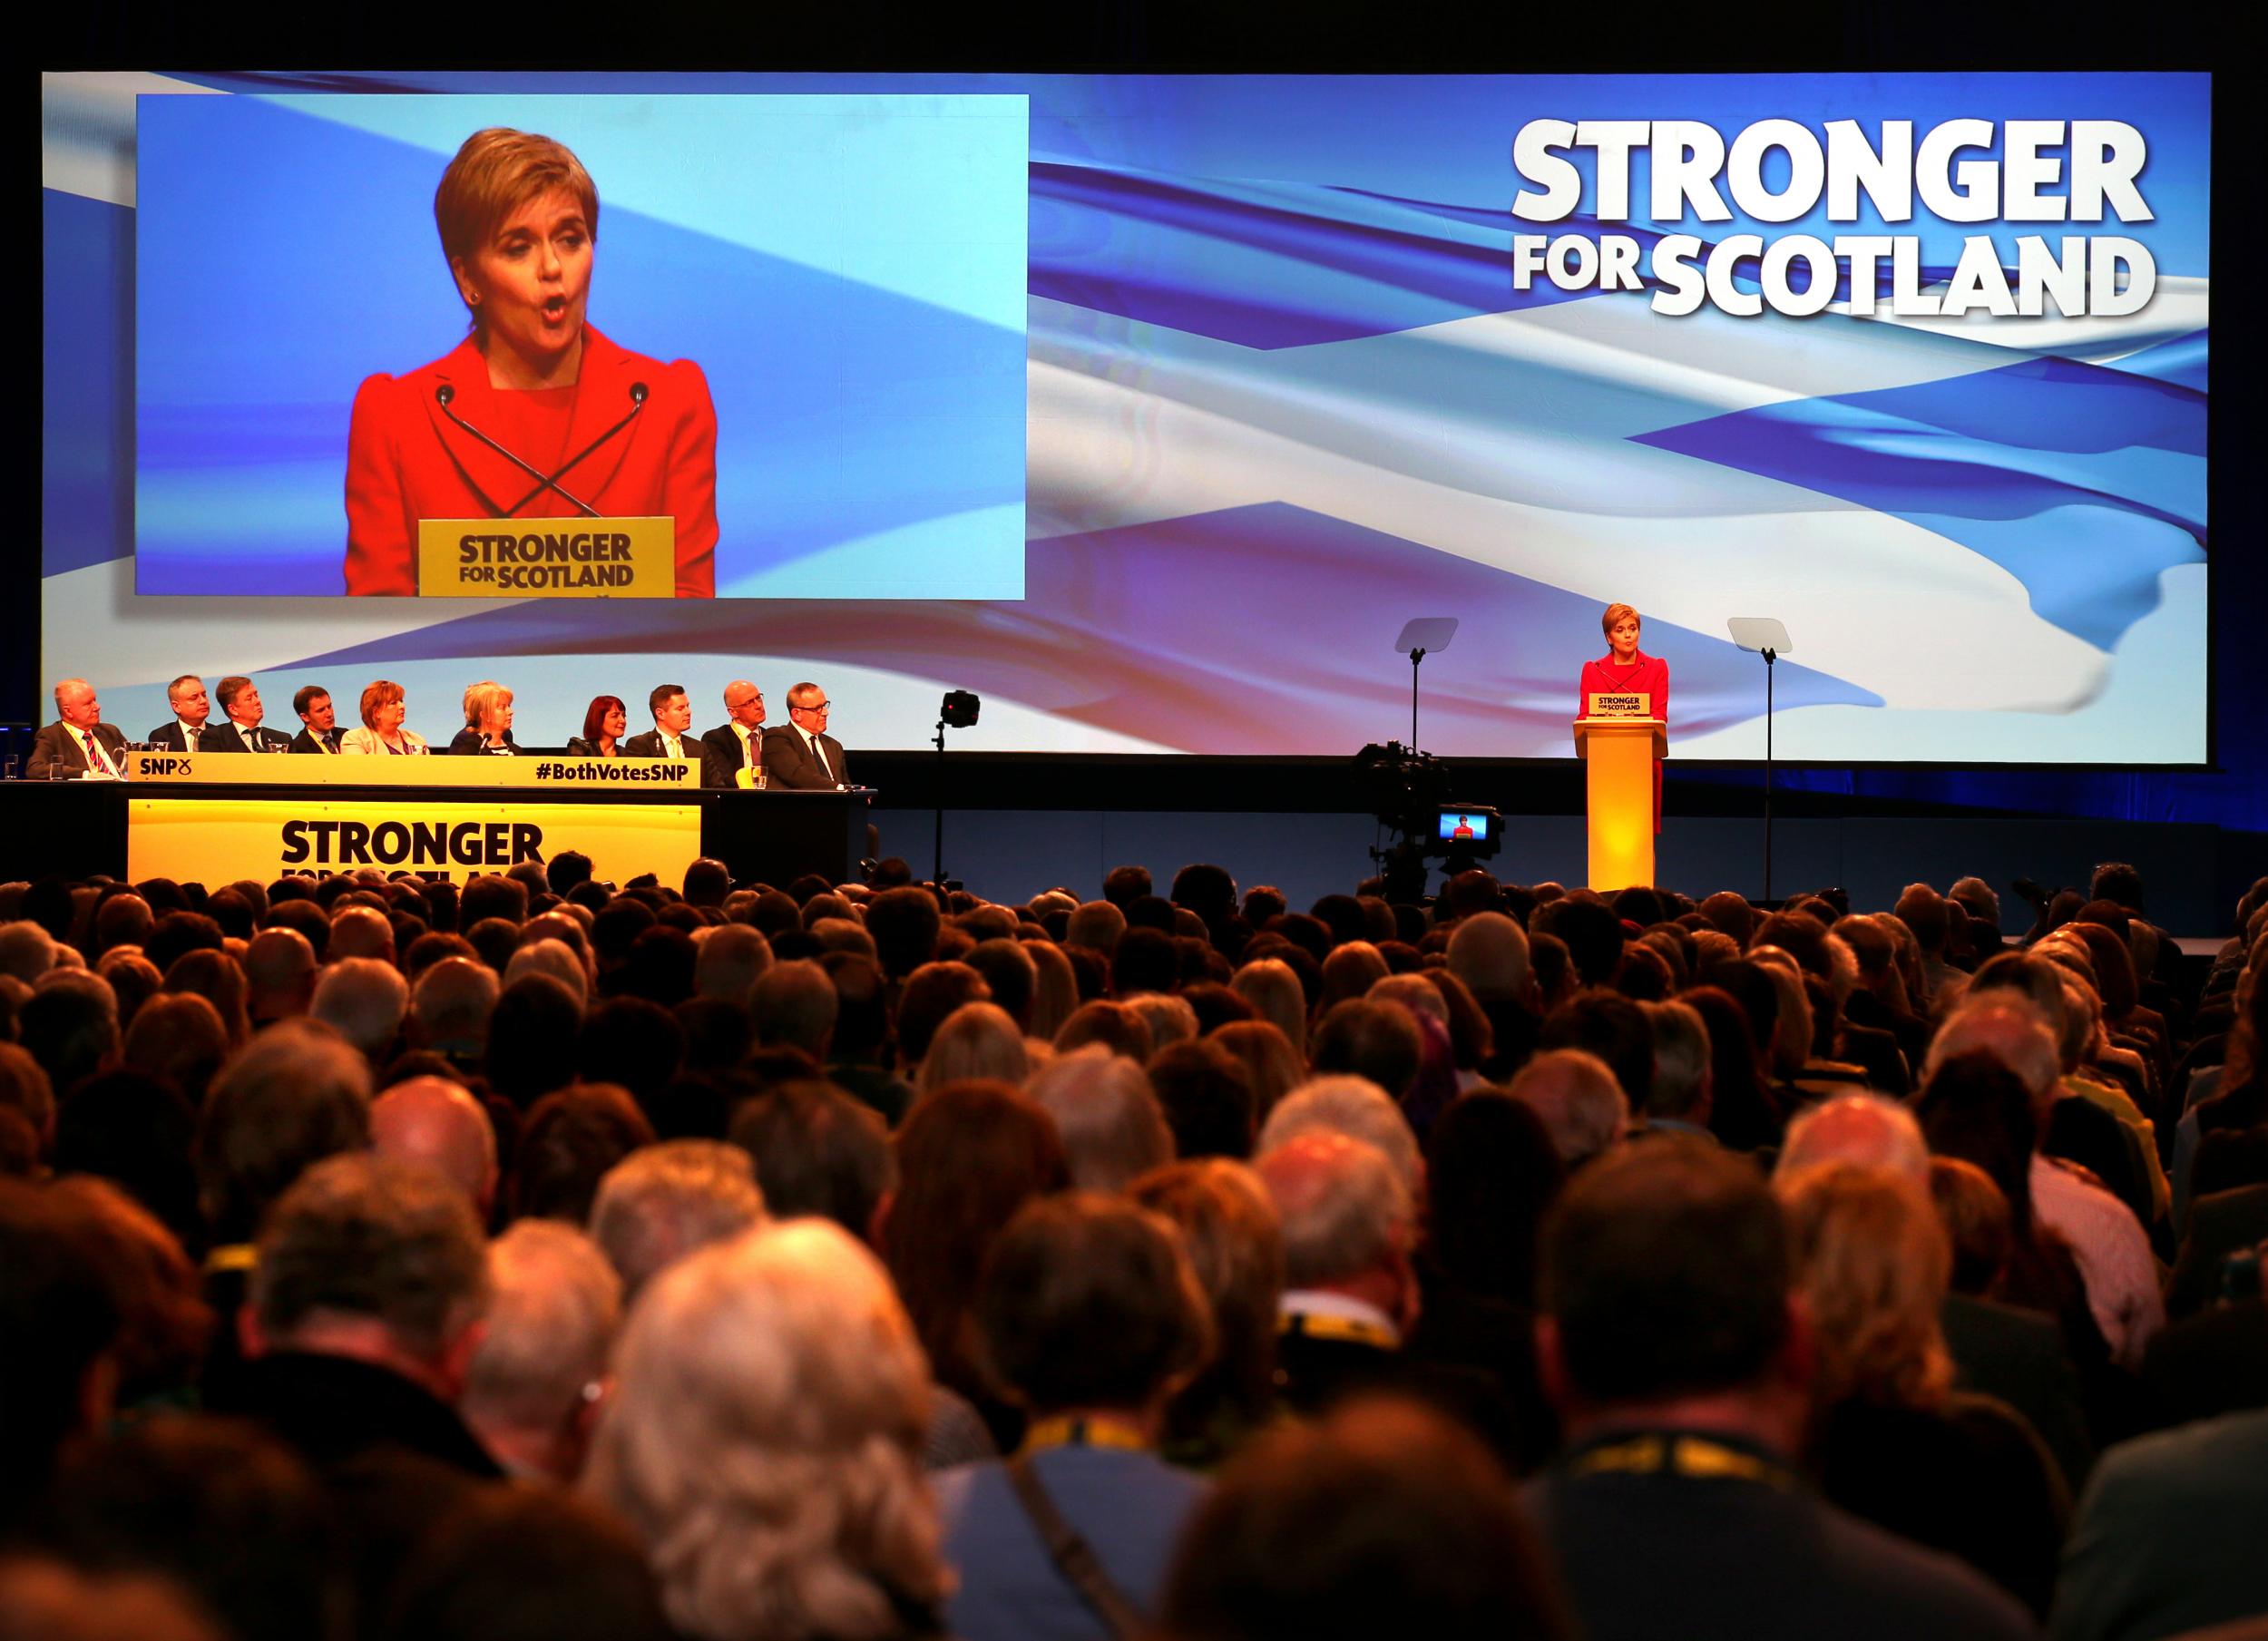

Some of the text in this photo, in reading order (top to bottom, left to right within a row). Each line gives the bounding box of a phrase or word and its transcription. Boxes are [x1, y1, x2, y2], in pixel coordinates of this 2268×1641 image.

[1510, 119, 2155, 222] STRONGER
[1512, 234, 2156, 318] FOR SCOTLAND
[459, 533, 633, 563] STRONGER
[459, 565, 634, 589] FOR SCOTLAND
[1598, 697, 1639, 705] STRONGER
[140, 758, 178, 775] SNP
[536, 762, 689, 781] #BothVotesSNP
[280, 820, 546, 865] STRONGER
